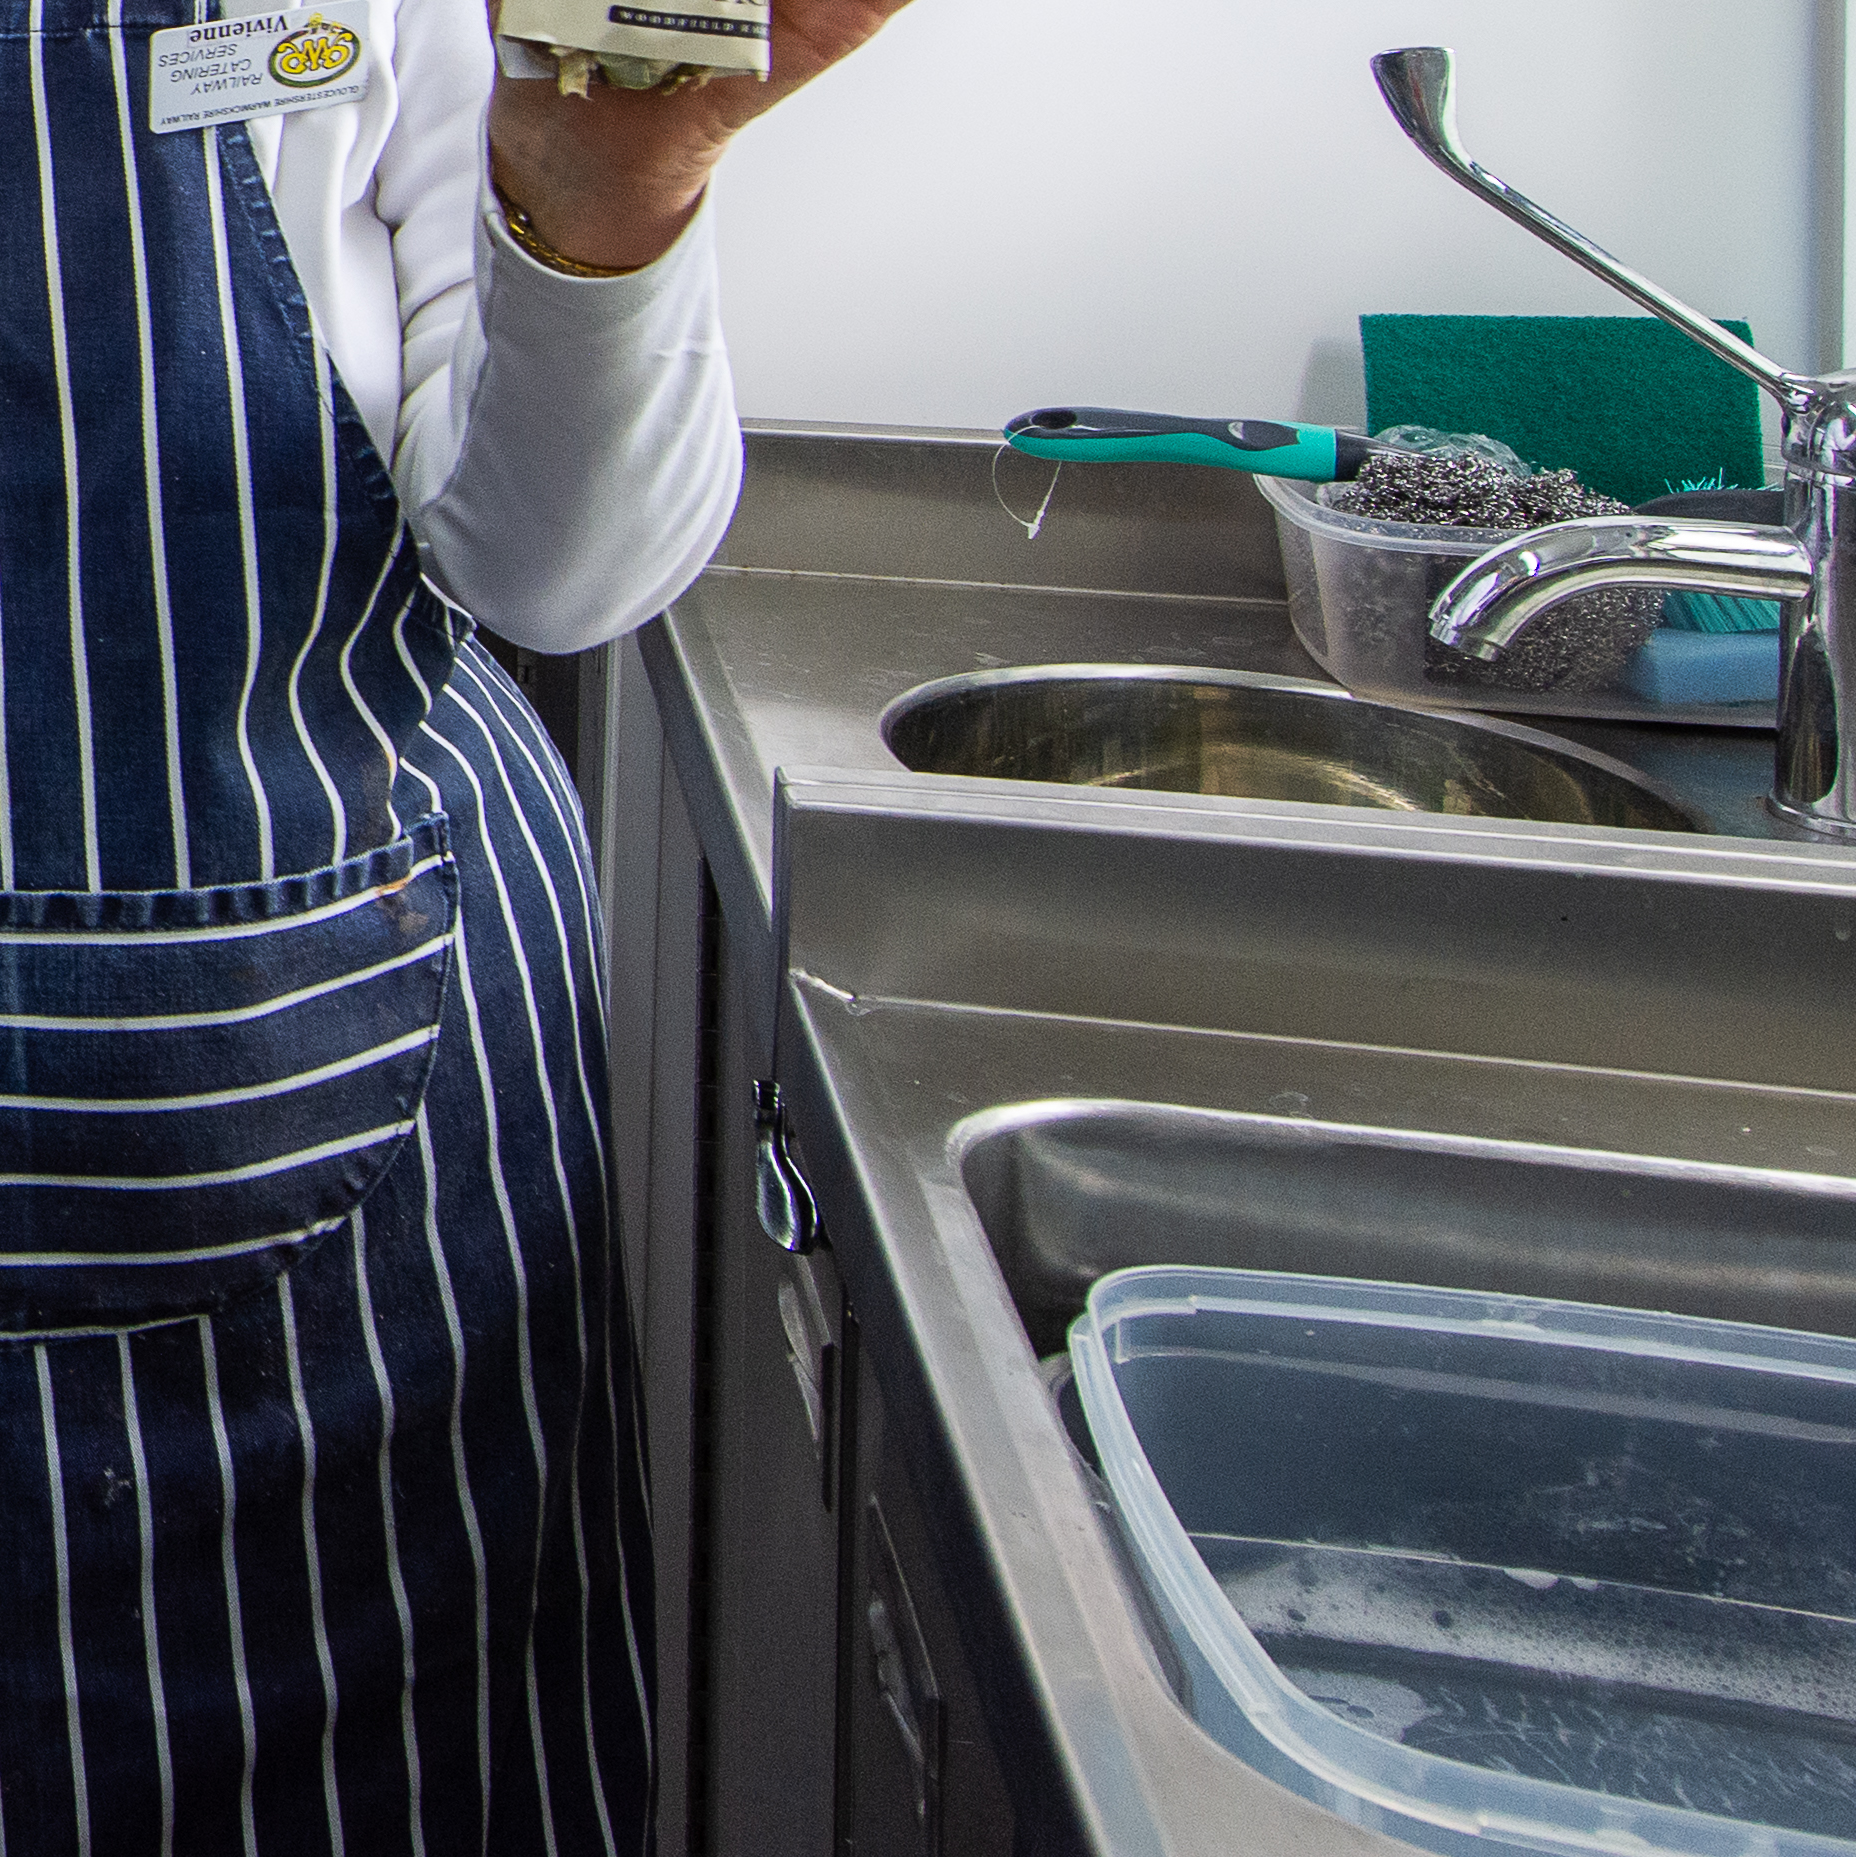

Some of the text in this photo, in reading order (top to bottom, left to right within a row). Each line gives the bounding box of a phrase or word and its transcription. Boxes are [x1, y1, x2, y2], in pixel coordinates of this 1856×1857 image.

[189, 15, 289, 42] Vivienne
[158, 43, 237, 67] SERVICES
[170, 58, 252, 82] CATERING
[190, 72, 263, 95] RAILWAY
[160, 85, 360, 126] GLOUCESTERSHIRE WARWICKSHIRE RAILWAY
